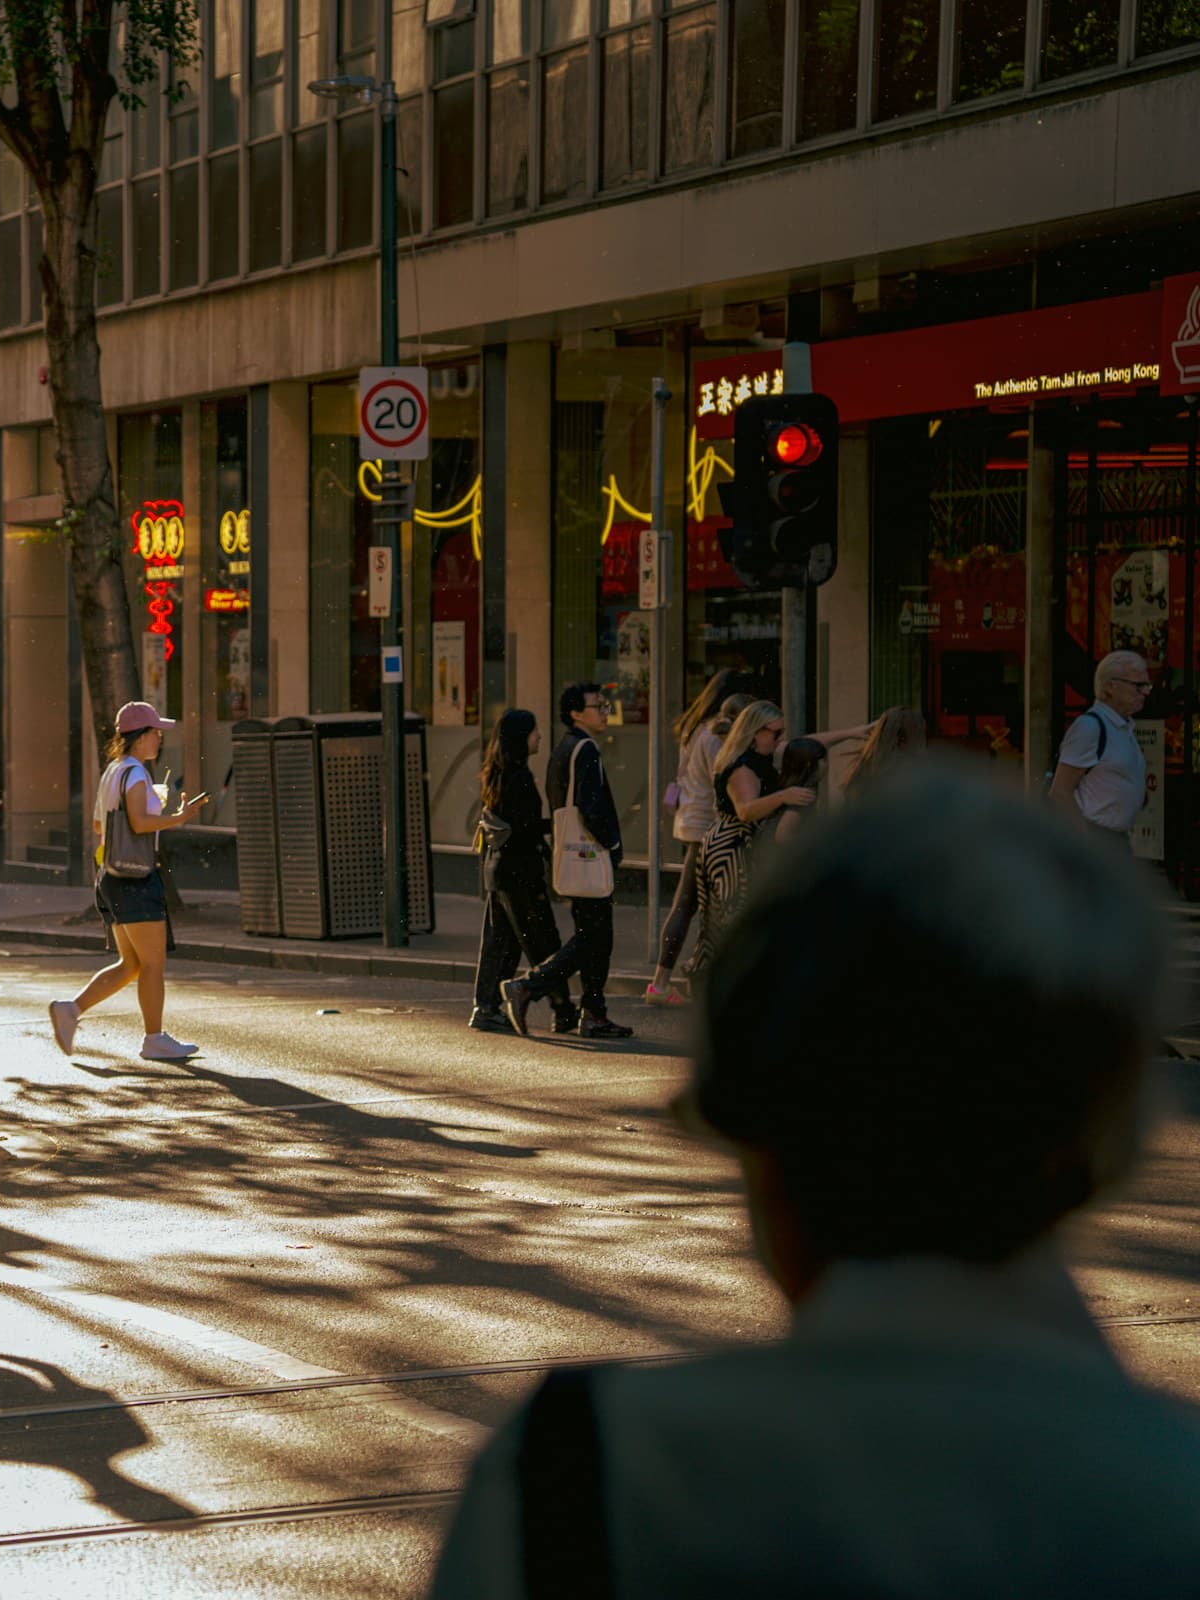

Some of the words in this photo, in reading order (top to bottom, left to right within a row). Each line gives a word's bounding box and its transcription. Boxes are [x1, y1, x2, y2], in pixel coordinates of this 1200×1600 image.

[974, 382, 993, 399] The
[993, 376, 1039, 396] Authentic
[1077, 371, 1101, 387] from
[1104, 367, 1131, 384] Hong
[1133, 363, 1160, 380] Kong
[375, 398, 417, 429] 20
